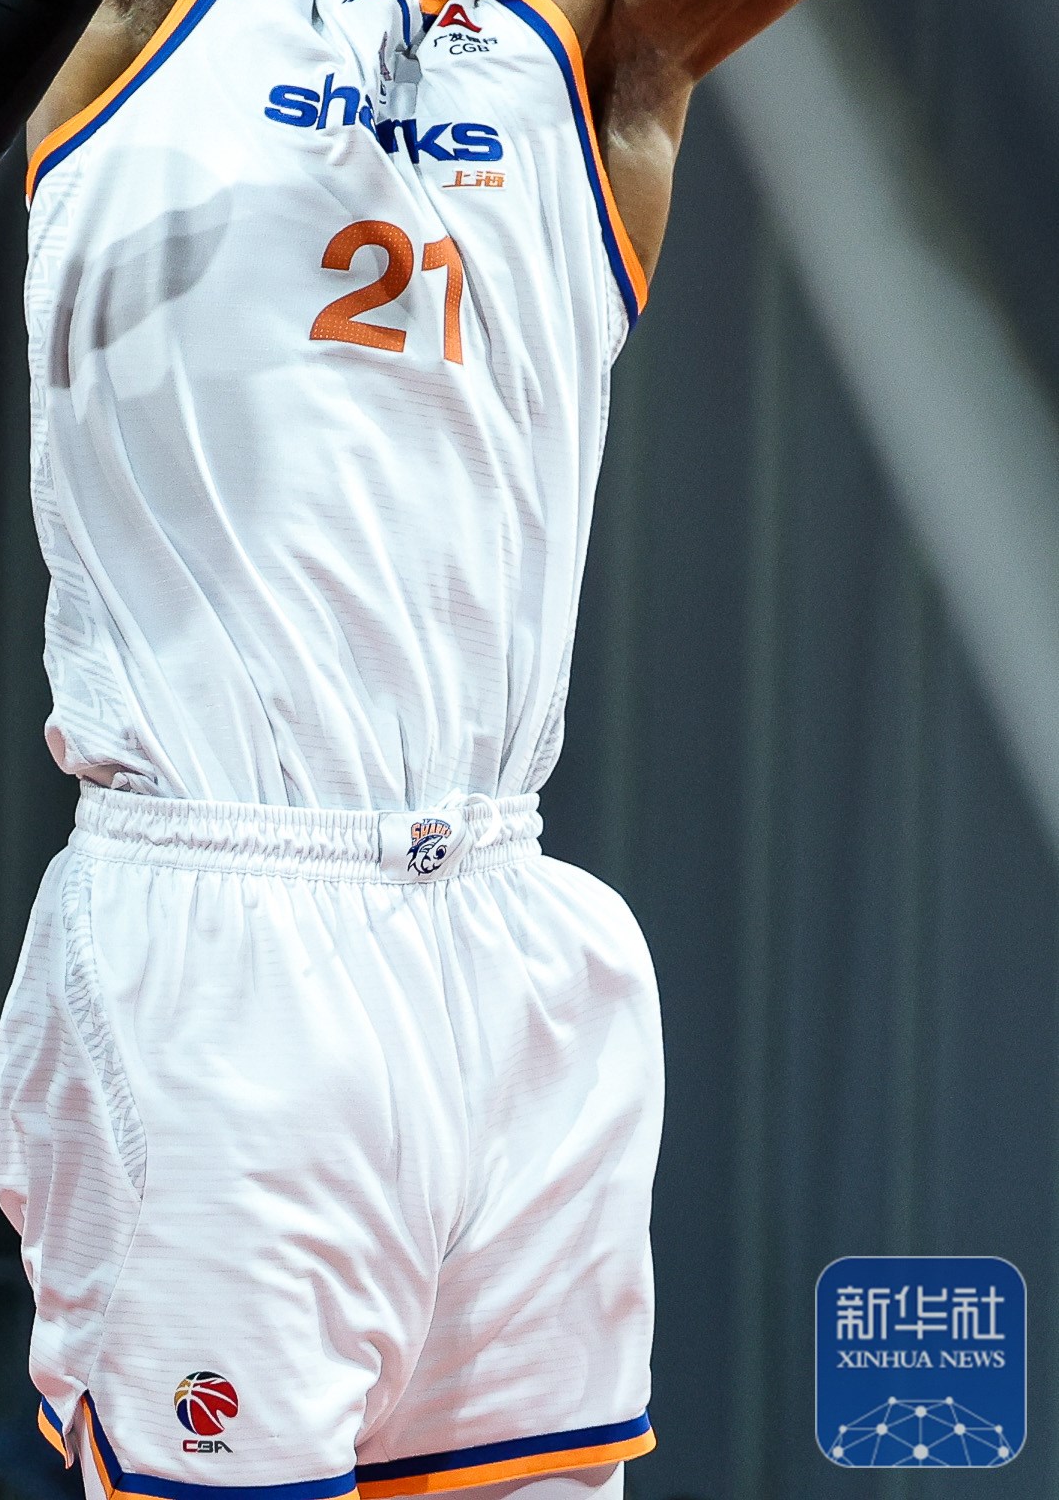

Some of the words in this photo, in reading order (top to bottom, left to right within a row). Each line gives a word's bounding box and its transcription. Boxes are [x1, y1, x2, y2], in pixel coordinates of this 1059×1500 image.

[449, 43, 490, 55] CGB
[442, 171, 506, 188] 上海
[309, 220, 464, 365] 21
[182, 1439, 234, 1453] CBA
